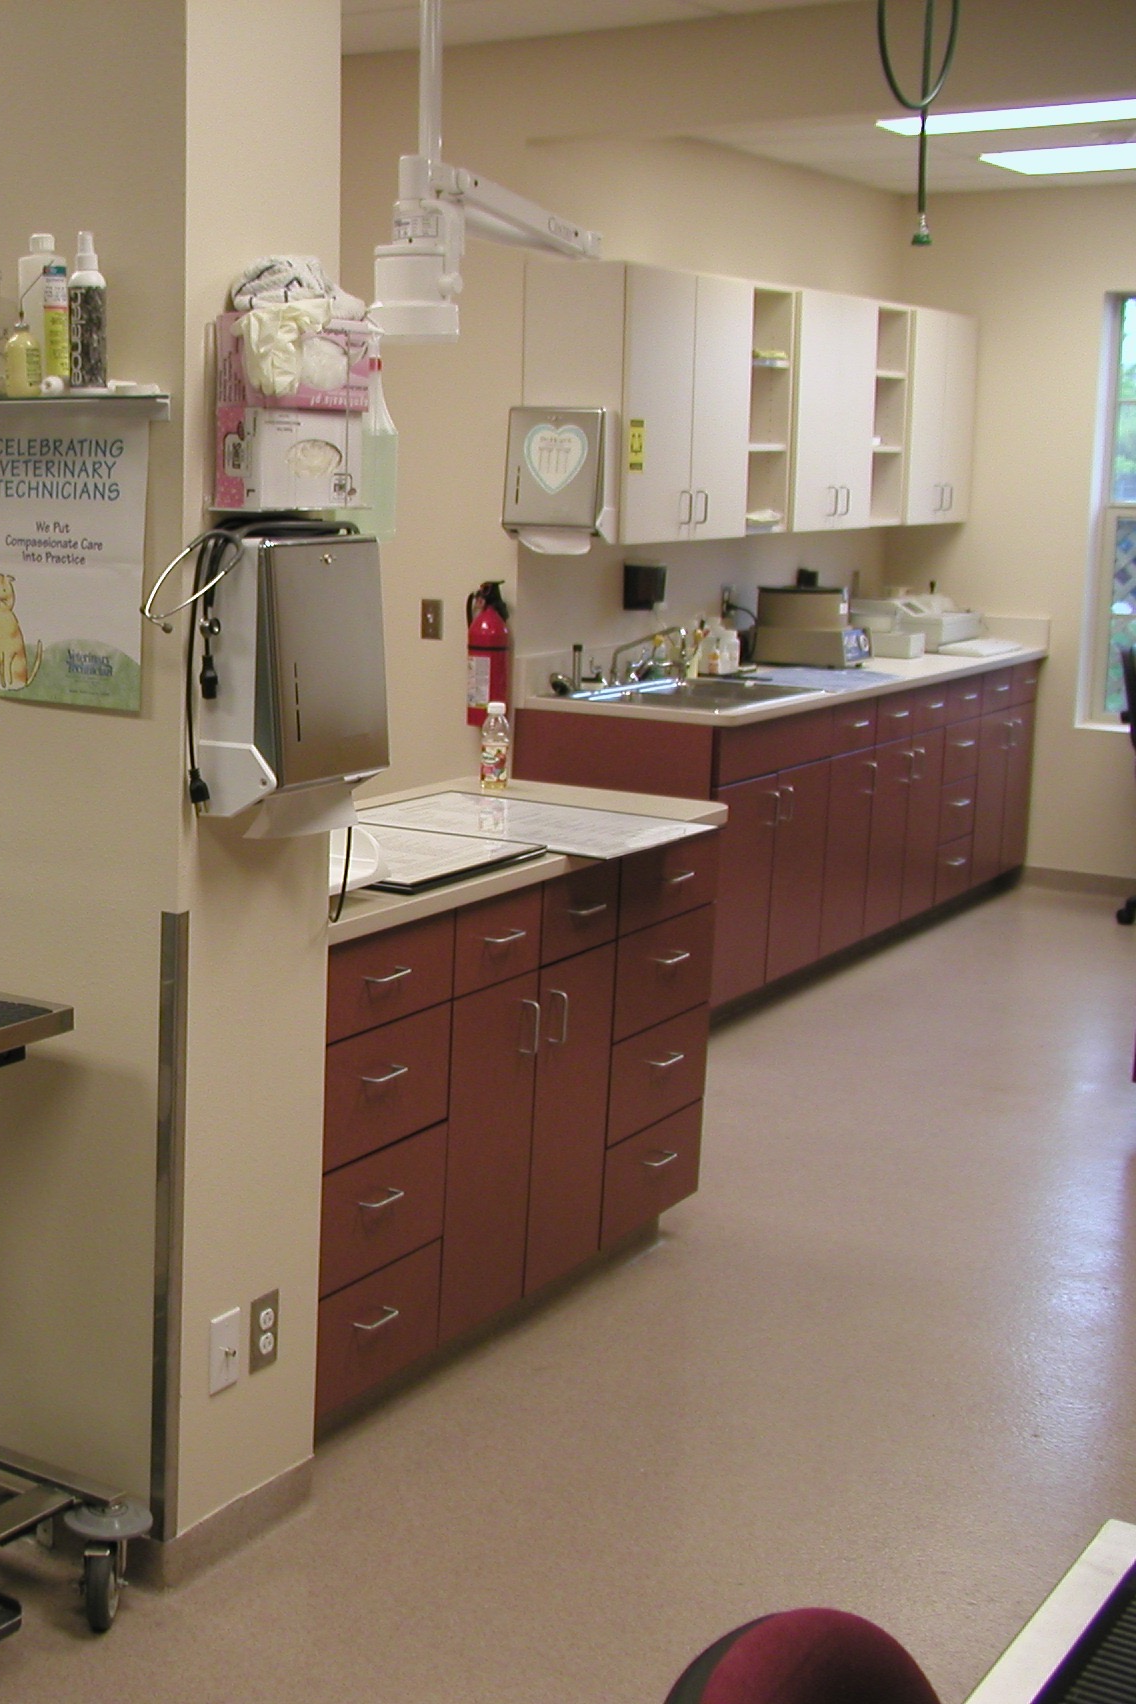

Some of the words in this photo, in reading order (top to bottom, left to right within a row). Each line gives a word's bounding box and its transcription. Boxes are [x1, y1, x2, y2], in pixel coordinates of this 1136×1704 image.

[0, 459, 117, 479] VETERINARY
[35, 520, 50, 534] We
[53, 521, 70, 534] Put
[5, 534, 79, 552] Compassionate
[80, 538, 104, 551] Care
[22, 551, 43, 563] Into
[45, 551, 86, 566] Practice
